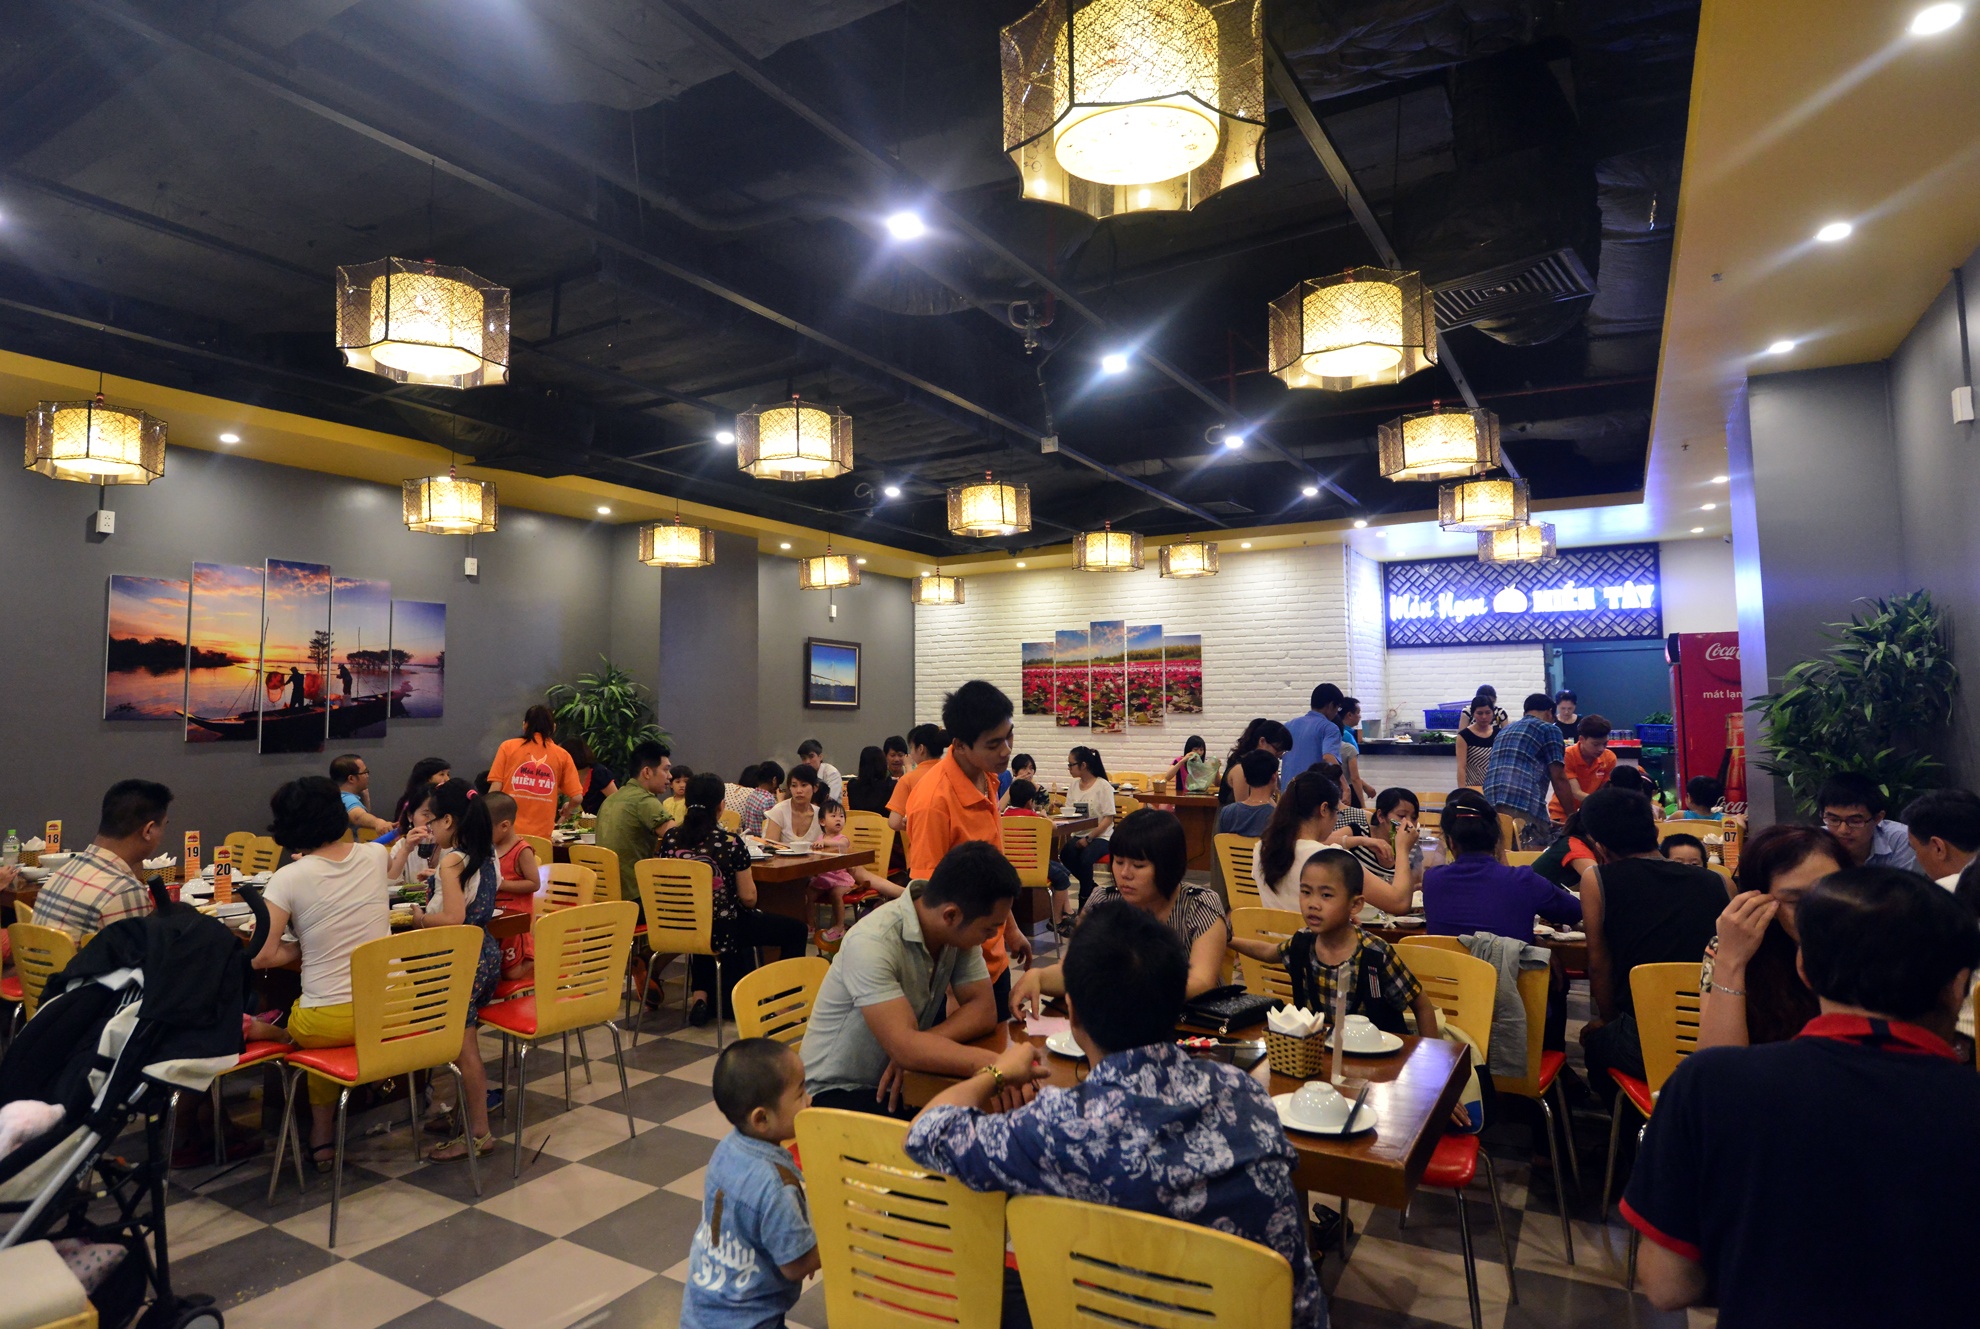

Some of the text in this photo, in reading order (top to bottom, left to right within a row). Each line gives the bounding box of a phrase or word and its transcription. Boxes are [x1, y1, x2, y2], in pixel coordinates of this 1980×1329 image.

[1603, 580, 1655, 610] TÂY
[1703, 690, 1725, 699] mát
[47, 833, 59, 845] 18
[1724, 831, 1737, 843] 07
[187, 846, 199, 858] 19
[216, 863, 231, 876] 20
